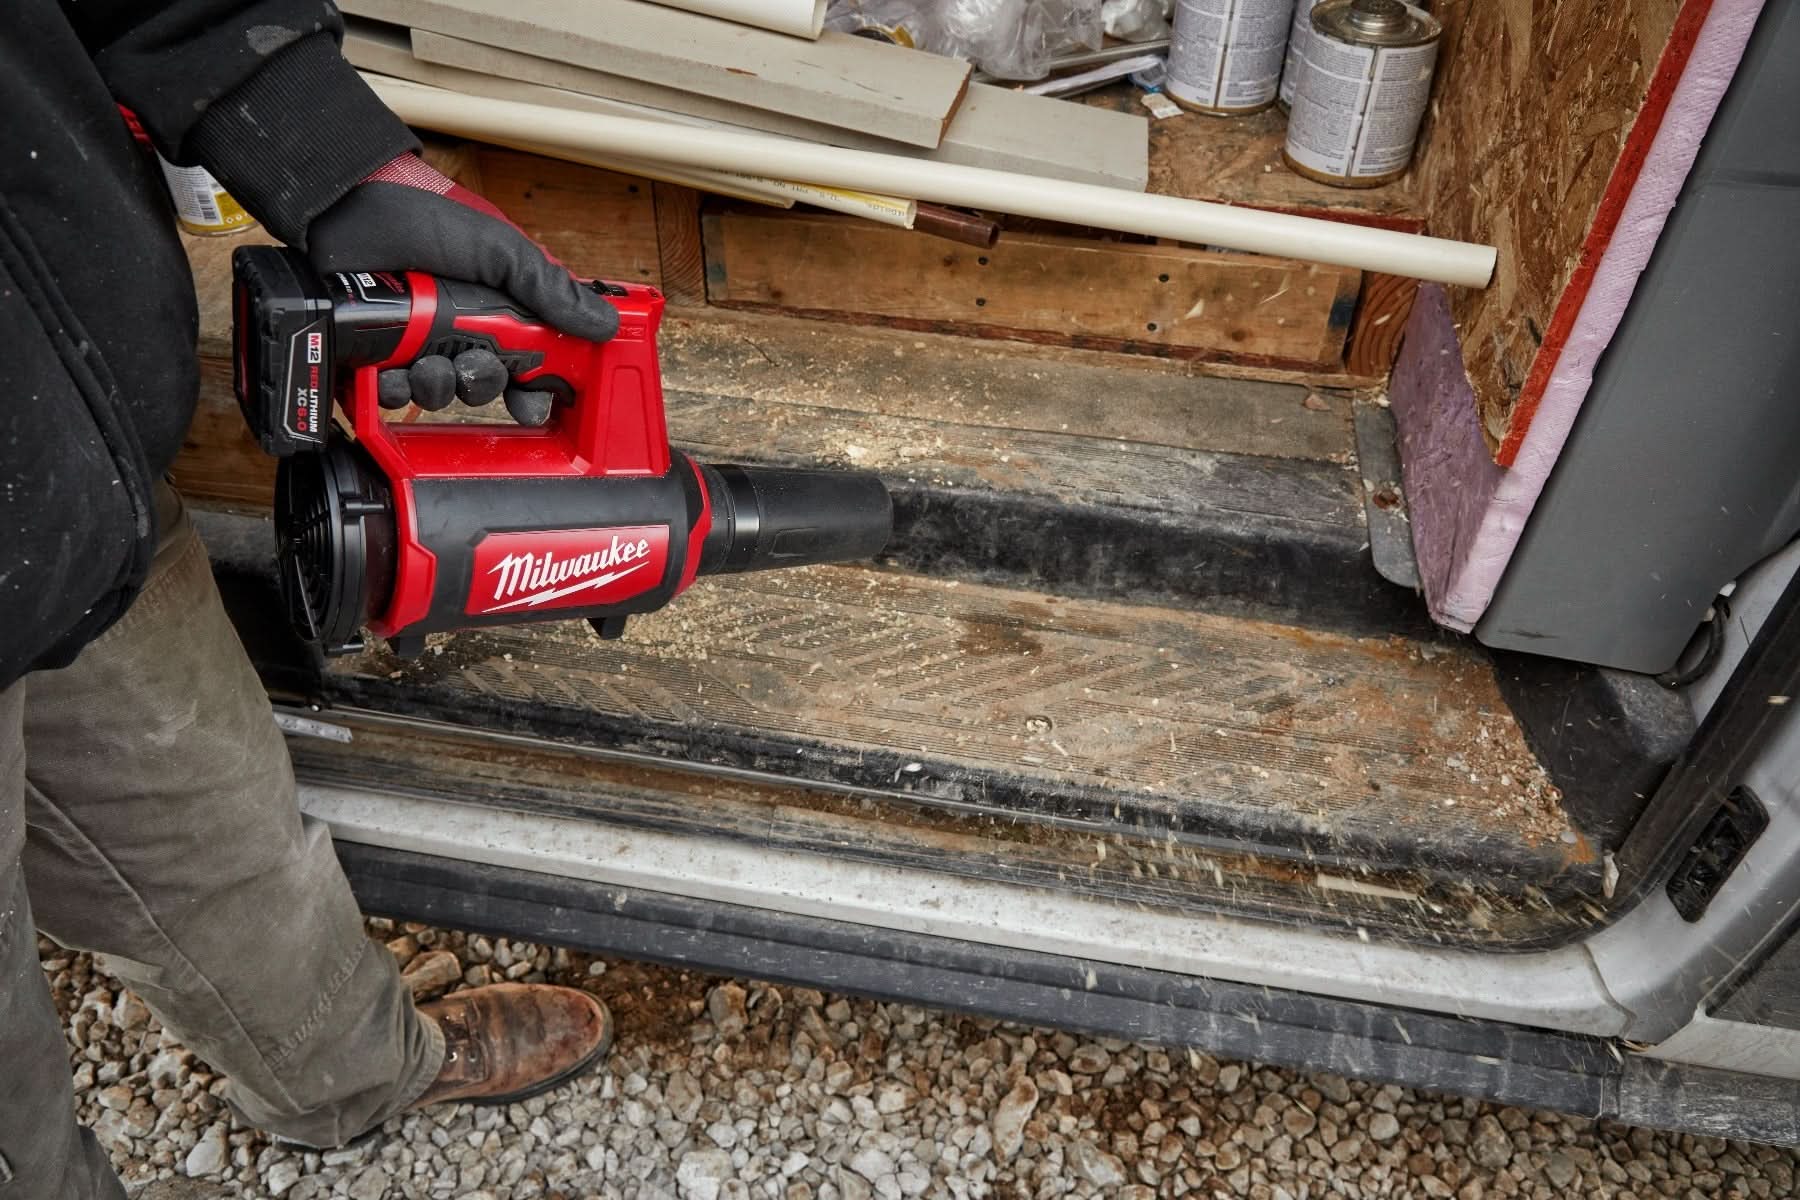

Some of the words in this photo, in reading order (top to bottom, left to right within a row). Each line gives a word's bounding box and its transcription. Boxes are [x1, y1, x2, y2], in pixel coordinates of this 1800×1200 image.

[310, 334, 319, 361] M12
[297, 387, 308, 432] XC6.0
[309, 365, 319, 433] REDLITHIUM
[487, 535, 651, 601] Milwaukee
